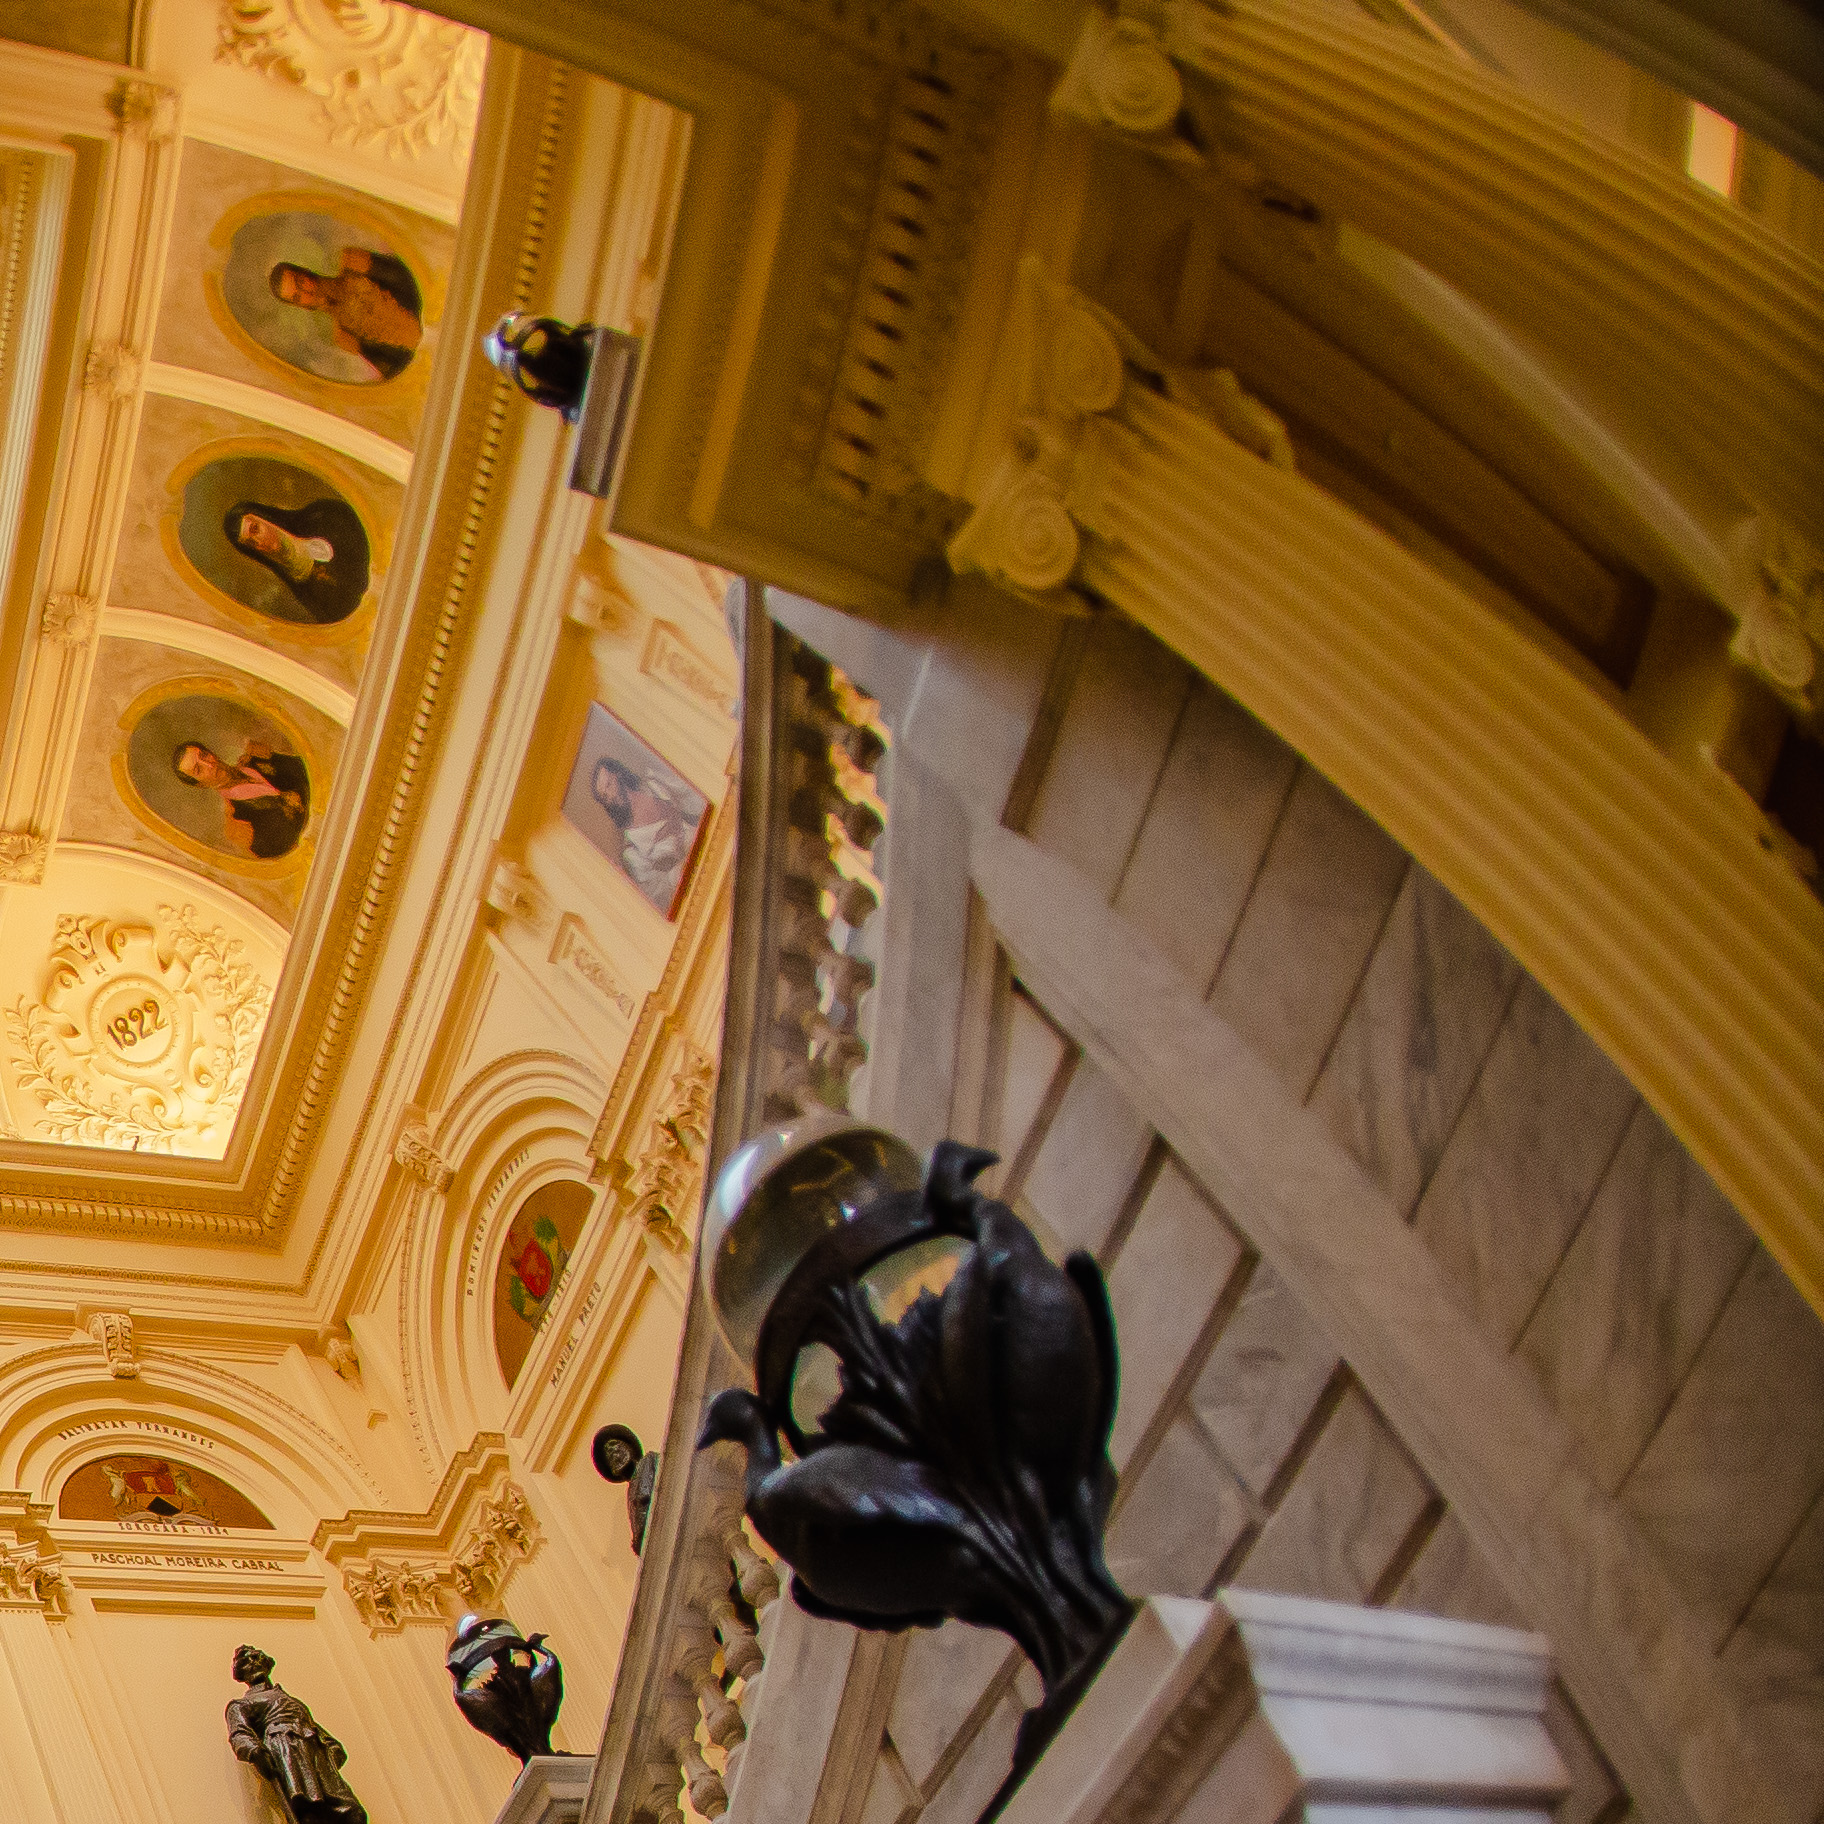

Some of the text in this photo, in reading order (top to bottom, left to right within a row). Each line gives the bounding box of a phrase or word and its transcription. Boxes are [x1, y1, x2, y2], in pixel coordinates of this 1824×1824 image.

[91, 1553, 284, 1572] PASCHOAL MOREIRA CABRAL
